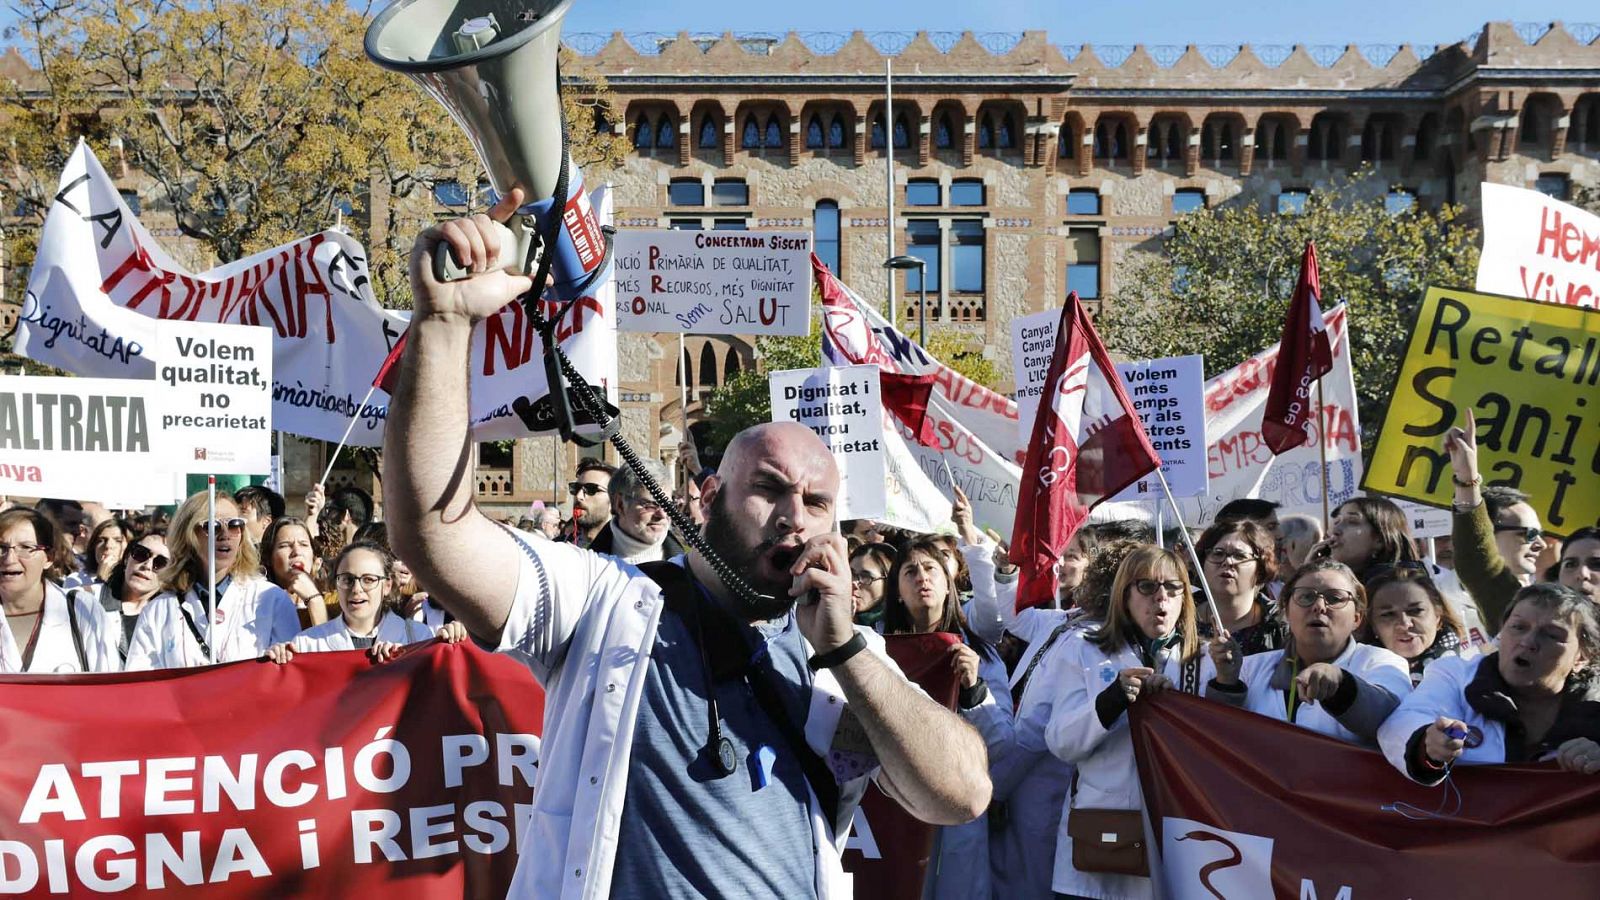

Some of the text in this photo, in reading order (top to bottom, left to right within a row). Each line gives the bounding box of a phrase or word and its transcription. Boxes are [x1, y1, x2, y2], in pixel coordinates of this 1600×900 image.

[563, 208, 579, 227] EN
[695, 233, 765, 250] CONCERTADA
[713, 257, 726, 271] DE
[617, 275, 640, 294] MÉS
[722, 278, 744, 298] MÉS
[1021, 322, 1053, 340] Canya!
[175, 336, 255, 361] Volem
[1022, 335, 1054, 353] Canya!
[1023, 353, 1054, 369] Canya
[161, 364, 268, 391] qualitat,
[1028, 368, 1050, 383] L'IC
[1124, 368, 1177, 383] Volem
[784, 381, 869, 402] Dignitat i
[1134, 382, 1169, 396] més
[200, 392, 231, 409] no
[1132, 397, 1178, 411] emps
[789, 401, 867, 422] qualitat,
[1155, 409, 1182, 422] als
[162, 413, 267, 430] precarietat
[828, 439, 879, 454] rietat
[1148, 438, 1192, 451] ents
[19, 726, 411, 824] ATENCIÓ
[0, 827, 272, 894] DIGNA
[299, 818, 320, 870] i
